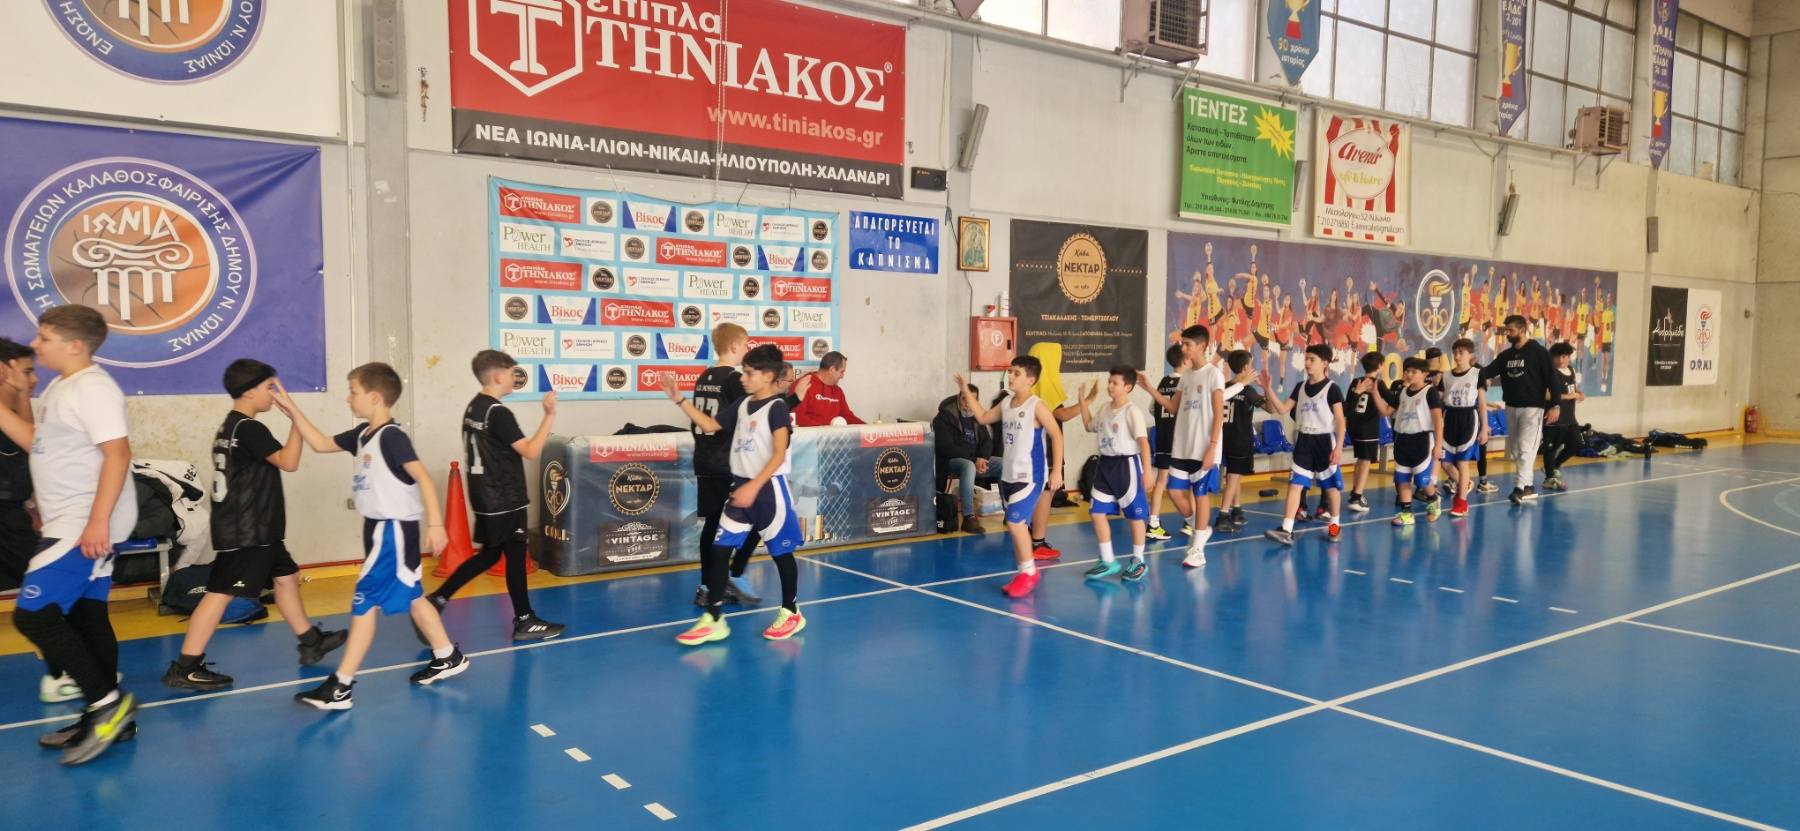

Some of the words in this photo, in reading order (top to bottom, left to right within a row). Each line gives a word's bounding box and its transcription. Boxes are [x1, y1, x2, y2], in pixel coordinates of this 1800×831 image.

[184, 39, 235, 73] ΙΩΝΙΑΣ
[586, 15, 885, 112] ΤΗΝΙΑΚΟΣ
[1188, 95, 1248, 126] ΤΕΝΤΕΣ
[475, 123, 520, 144] ΝΕΑ
[707, 106, 884, 149] www.tiniakos.gr
[62, 170, 231, 234] ΚΑΛΑΘΟΣΦΑΙΡΙΣΗΣ
[636, 210, 664, 225] Βίκος
[855, 215, 934, 236] ΑΠΑΓΟΡΕΥΕΤΑΙ
[24, 194, 67, 290] ΣΩΜΑΤΕΙΩΝ
[889, 236, 900, 249] ΤΟ
[221, 236, 243, 295] ΔΗΜΟΥ
[769, 254, 793, 266] Βίκος
[858, 252, 930, 270] ΚΑΠΝΙΣΜΑ
[1064, 262, 1100, 273] ΝΕΚΤΑΡ
[551, 305, 583, 318] Βίκος
[168, 313, 224, 352] ΙΩΝΙΑΣ
[668, 342, 696, 353] Βίκος
[553, 374, 584, 386] Βίκος
[880, 465, 906, 474] ΝΕΚΤΑΡ
[615, 484, 653, 494] ΝΕΚΤΑΡ
[875, 509, 911, 518] VINTAGE
[611, 533, 659, 545] VINTAGE
